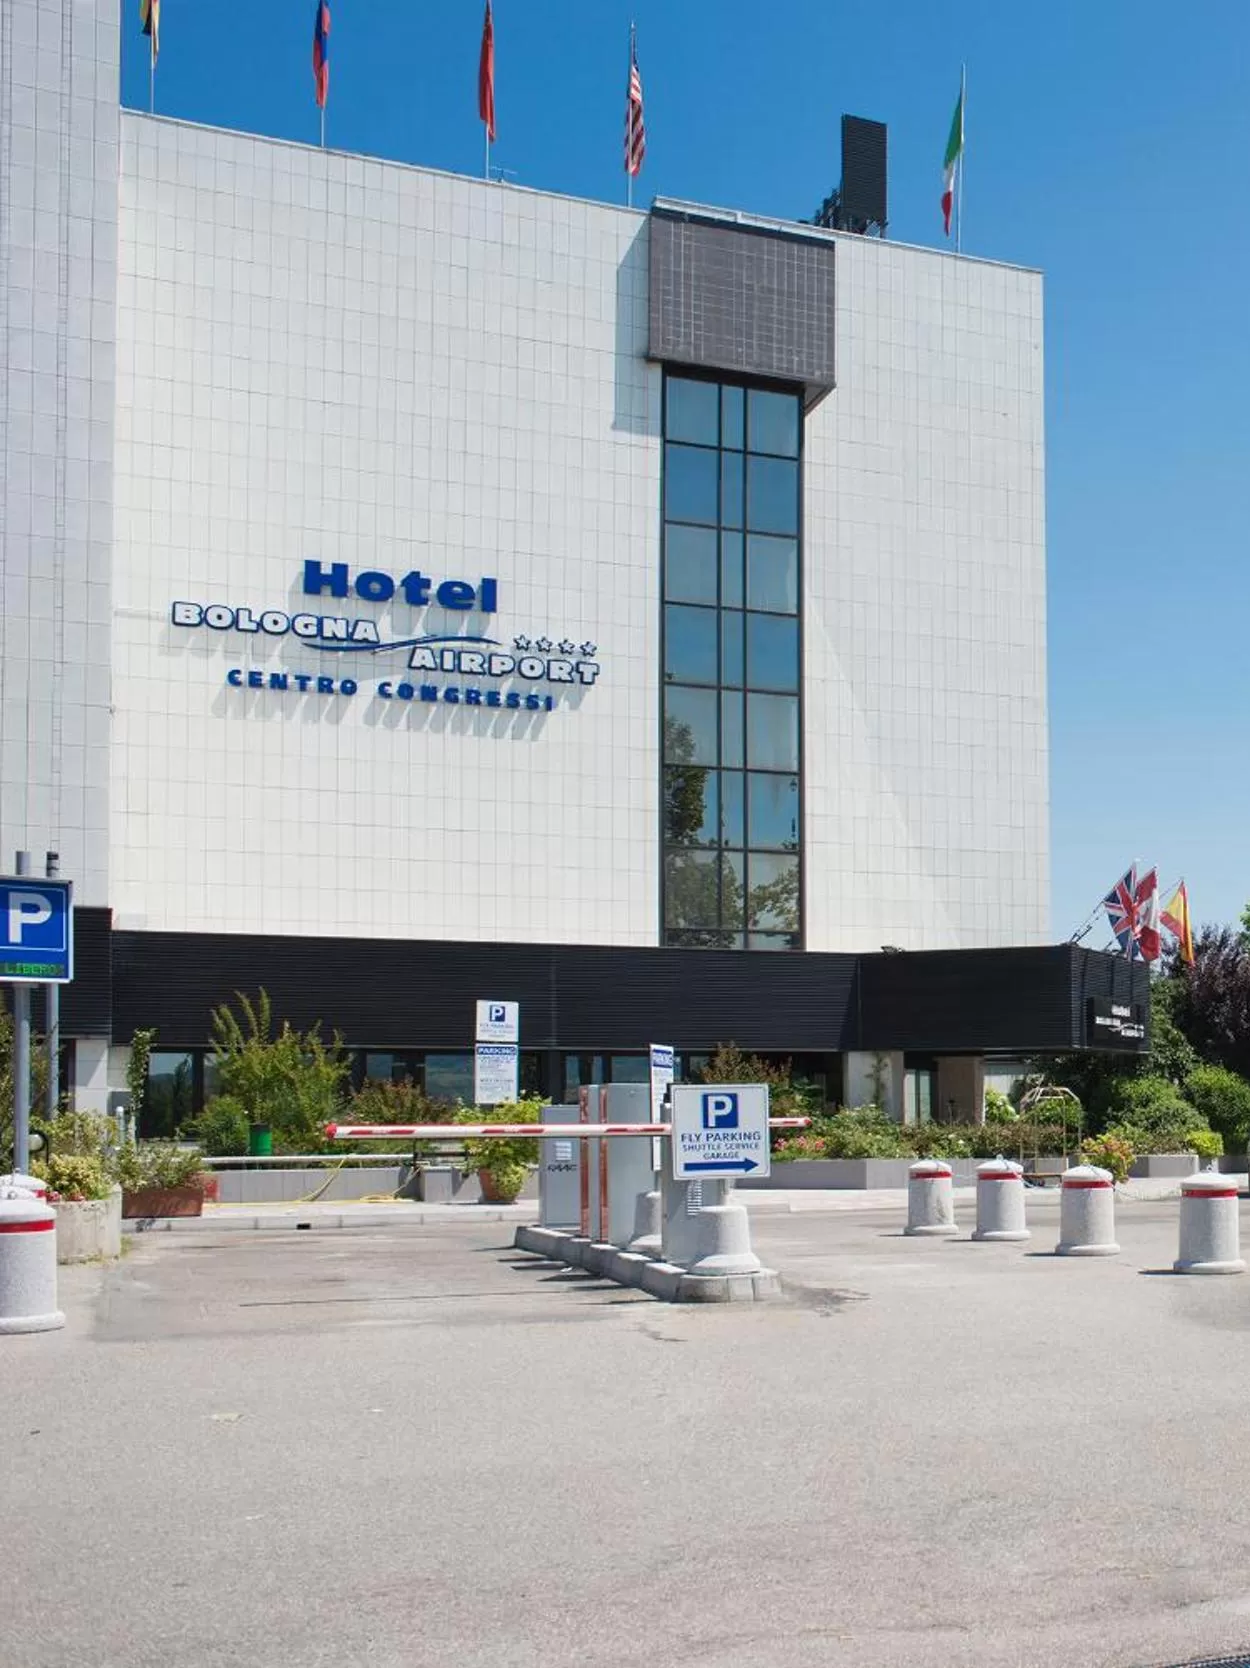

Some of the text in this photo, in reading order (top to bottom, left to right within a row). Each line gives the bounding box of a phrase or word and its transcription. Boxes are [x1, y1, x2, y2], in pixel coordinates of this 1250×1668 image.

[303, 559, 498, 614] Hotel
[172, 601, 380, 643] BOLOGNA
[408, 647, 600, 684] AIRPORT
[226, 668, 554, 712] CENTRO CONGRESSI
[8, 892, 53, 944] P
[491, 1006, 504, 1021] P
[707, 1095, 733, 1127] P
[681, 1131, 761, 1143] FLY PARKING
[682, 1142, 760, 1152] SHUTTLE SERVICE
[703, 1152, 740, 1160] GARAGE
